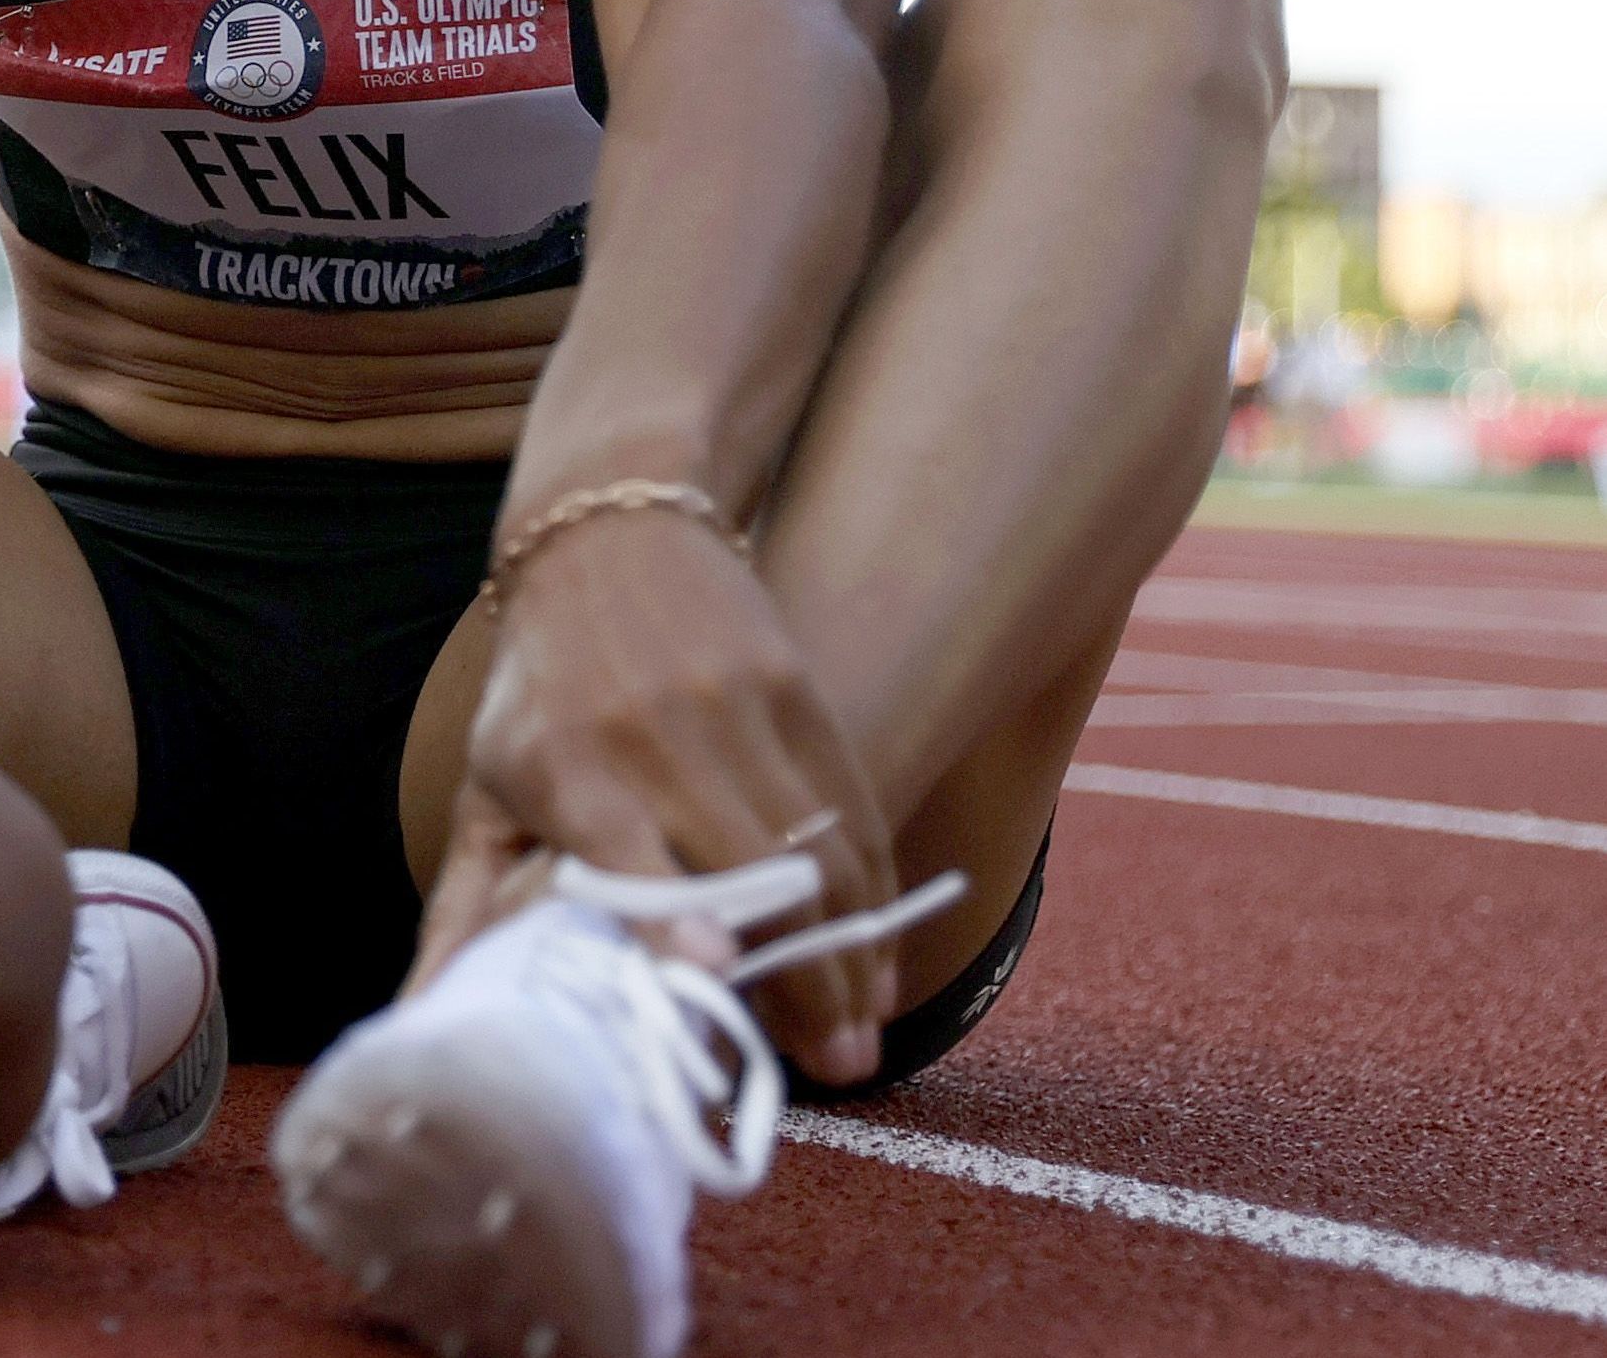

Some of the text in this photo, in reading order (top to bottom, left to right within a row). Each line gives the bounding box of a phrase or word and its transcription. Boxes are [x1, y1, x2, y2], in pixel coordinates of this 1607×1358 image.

[355, 21, 537, 71] TEAM TRIALS
[360, 62, 485, 89] TRACK & FIELD
[204, 88, 314, 118] OLYMPIC TEAM
[160, 130, 451, 220] FELIX
[194, 241, 456, 306] TRACKTOWN
